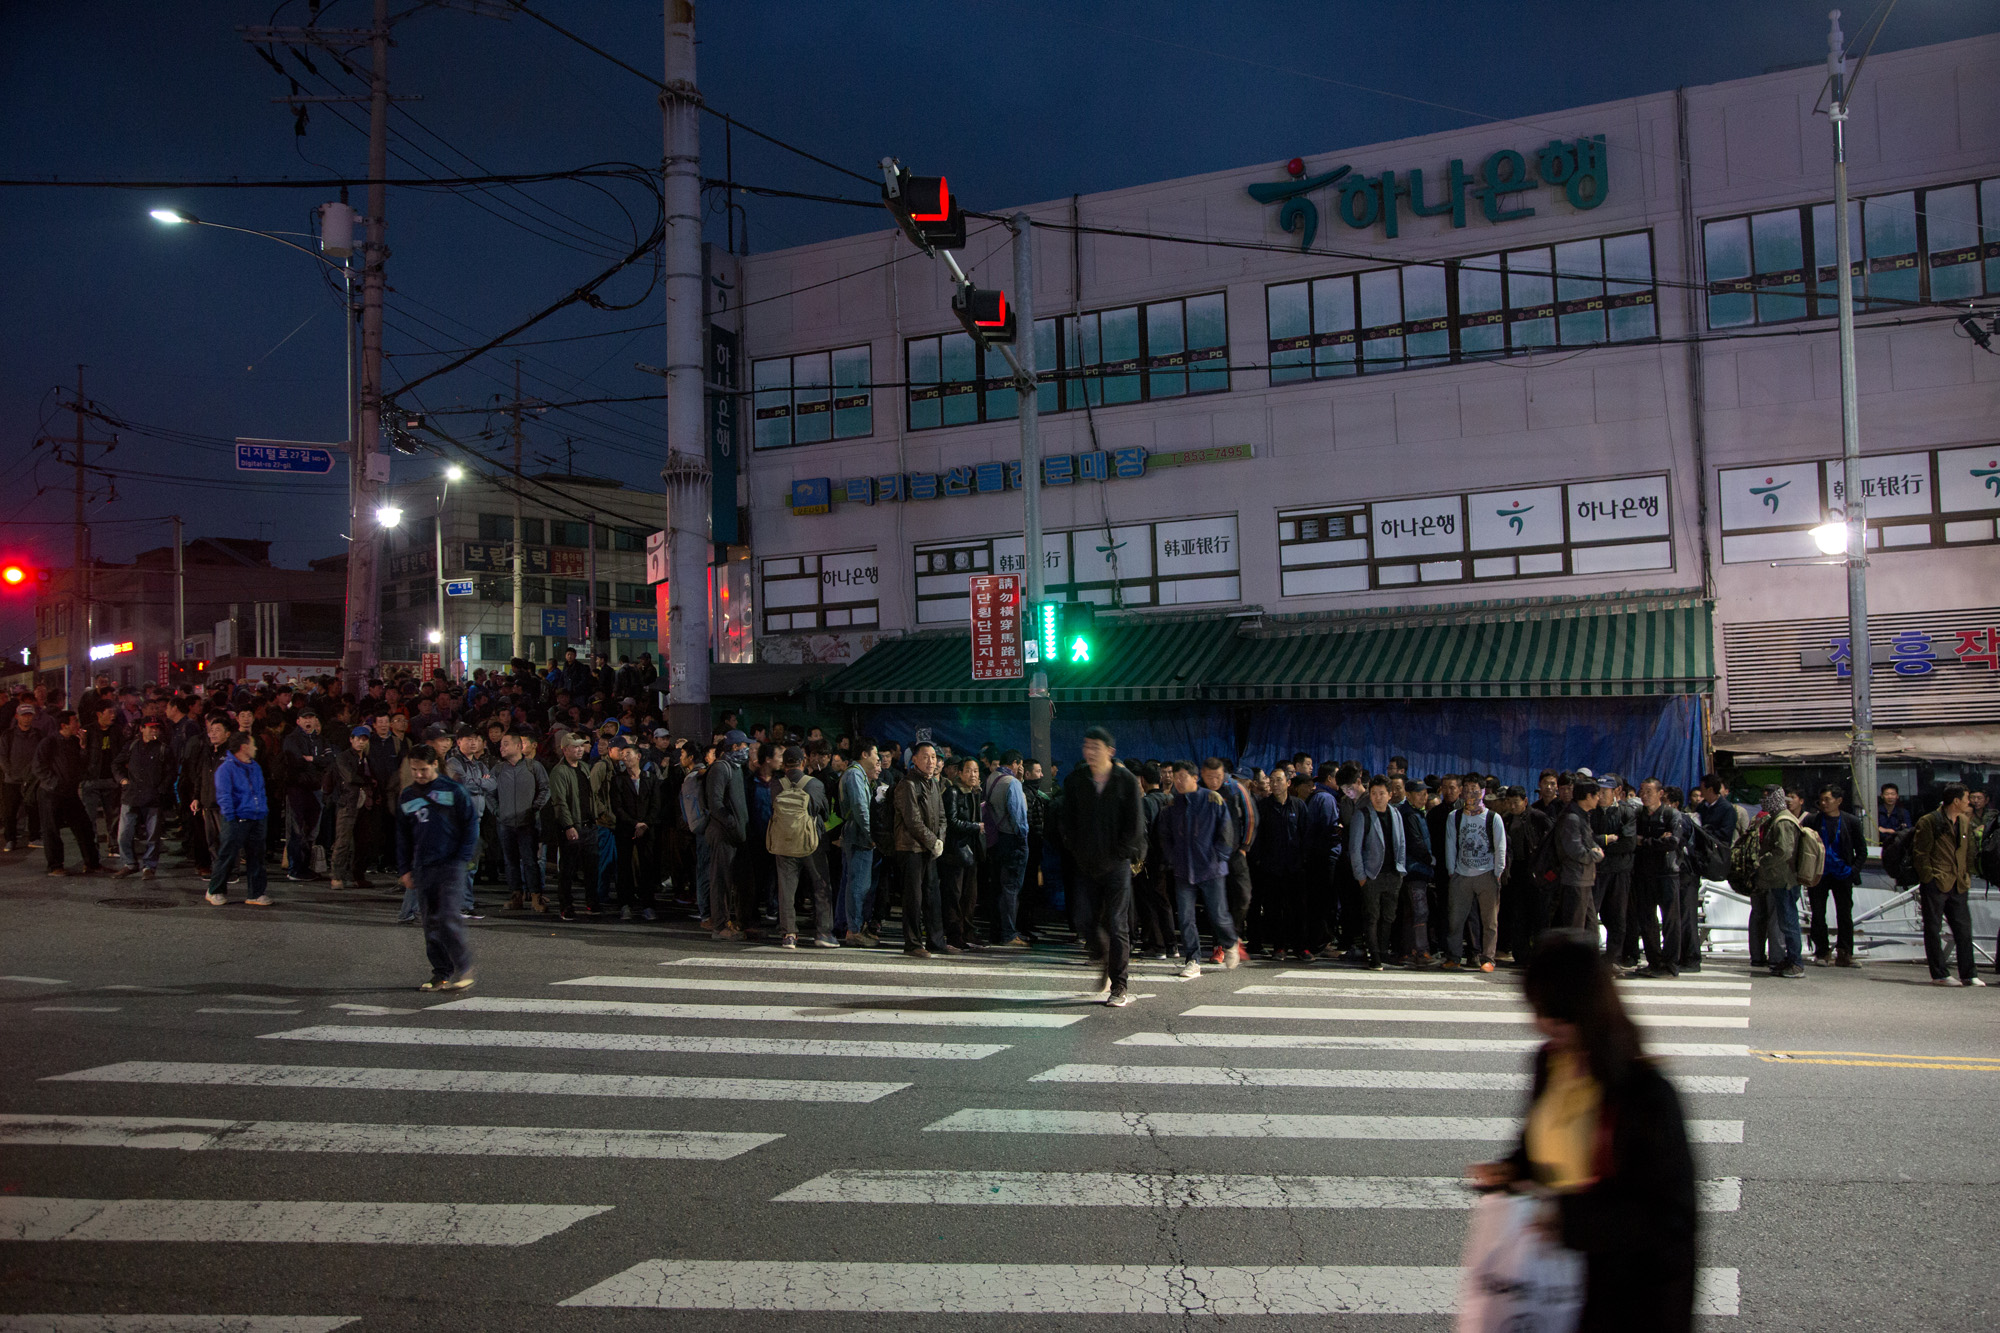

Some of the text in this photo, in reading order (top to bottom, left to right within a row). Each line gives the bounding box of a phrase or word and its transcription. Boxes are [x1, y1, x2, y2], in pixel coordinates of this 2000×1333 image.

[1339, 134, 1609, 239] 하나은행
[1958, 252, 1977, 262] PC
[1896, 259, 1914, 268] PC
[1783, 274, 1801, 283] PC
[1636, 295, 1652, 304] PC
[1587, 301, 1603, 310] PC
[1538, 309, 1554, 318] PC
[1487, 314, 1503, 323] PC
[1432, 321, 1448, 330] PC
[1388, 328, 1403, 336] PC
[1340, 334, 1354, 343] PC
[1295, 340, 1310, 349] PC
[1210, 351, 1223, 359] PC
[1170, 357, 1183, 365] PC
[1124, 363, 1137, 371] PC
[960, 385, 973, 393] PC
[927, 391, 939, 399] PC
[814, 404, 826, 412] PC
[775, 409, 786, 417] PC
[1577, 495, 1660, 521] 하나은행
[1380, 514, 1456, 539] 하나은행
[1164, 536, 1231, 558] 韩亚银行
[999, 551, 1061, 572] 韩亚行
[823, 566, 878, 587] 하나은행
[976, 578, 993, 657] 무단횡단금지
[998, 577, 1016, 657] 請勿橫穿馬路
[976, 668, 1022, 678] 구로경찰서
